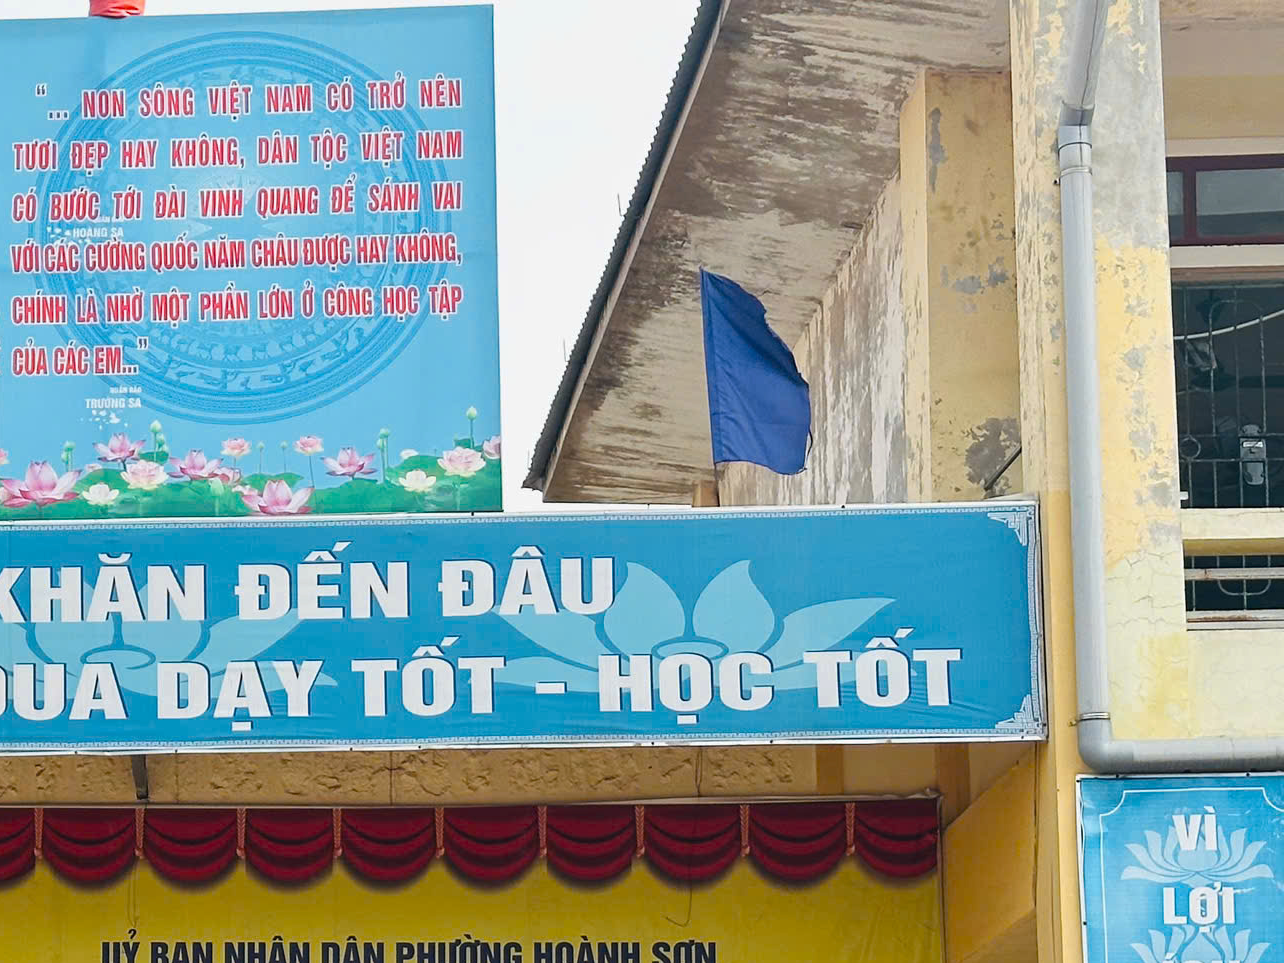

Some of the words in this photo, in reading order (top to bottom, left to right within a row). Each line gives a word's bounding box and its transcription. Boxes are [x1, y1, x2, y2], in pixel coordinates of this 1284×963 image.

[82, 88, 125, 119] NON
[139, 83, 194, 118] SÔNG
[207, 80, 252, 120] VIỆT
[265, 83, 313, 113] NAM
[326, 76, 354, 112] CÓ
[367, 71, 406, 110] TRỞ
[419, 74, 462, 108] NÊN
[13, 139, 58, 171] TƯƠI
[70, 140, 109, 176] ĐẸP
[120, 139, 159, 169] HAY
[171, 132, 245, 169] KHÔNG,
[257, 130, 298, 165] DÂN
[309, 127, 348, 169] TỘC
[360, 126, 404, 167] VIỆT
[417, 129, 463, 160] NAM
[12, 187, 37, 222] CÓ
[49, 187, 99, 221] BƯỚC
[113, 185, 142, 220] TỚI
[154, 185, 187, 219] ĐÀI
[200, 189, 244, 218] VINH
[256, 186, 319, 218] QUANG
[330, 174, 357, 214] ĐỂ
[367, 177, 420, 213] SÁNH
[432, 181, 462, 211] VAI
[10, 238, 40, 273] VỚI
[44, 238, 79, 273] CÁC
[84, 236, 146, 272] CƯỜNG
[150, 232, 198, 273] QUỐC
[203, 235, 246, 269] NĂM
[250, 233, 299, 268] CHÂU
[302, 235, 351, 271] ĐƯỢC
[355, 234, 390, 265] HAY
[394, 228, 462, 265] KHÔNG,
[11, 290, 67, 324] CHÍNH
[75, 288, 98, 323] LÀ
[105, 286, 144, 323] NHỜ
[151, 287, 190, 328] MỘT
[199, 281, 249, 322] PHẦN
[257, 284, 294, 319] LỚN
[300, 279, 314, 318] Ở
[323, 282, 374, 317] CÔNG
[382, 284, 420, 322] HỌC
[428, 279, 463, 321] TẬP
[11, 338, 48, 376] CỦA
[53, 340, 90, 376] CÁC
[233, 541, 411, 621] ĐẾN
[438, 545, 615, 616] ĐÂU
[156, 660, 323, 731] DẠY
[352, 635, 507, 718] TỐT
[535, 681, 566, 694] -
[599, 652, 774, 725] HỌC
[803, 627, 962, 708] TỐT
[1172, 806, 1217, 851] VÌ
[1163, 882, 1236, 933] LỢI
